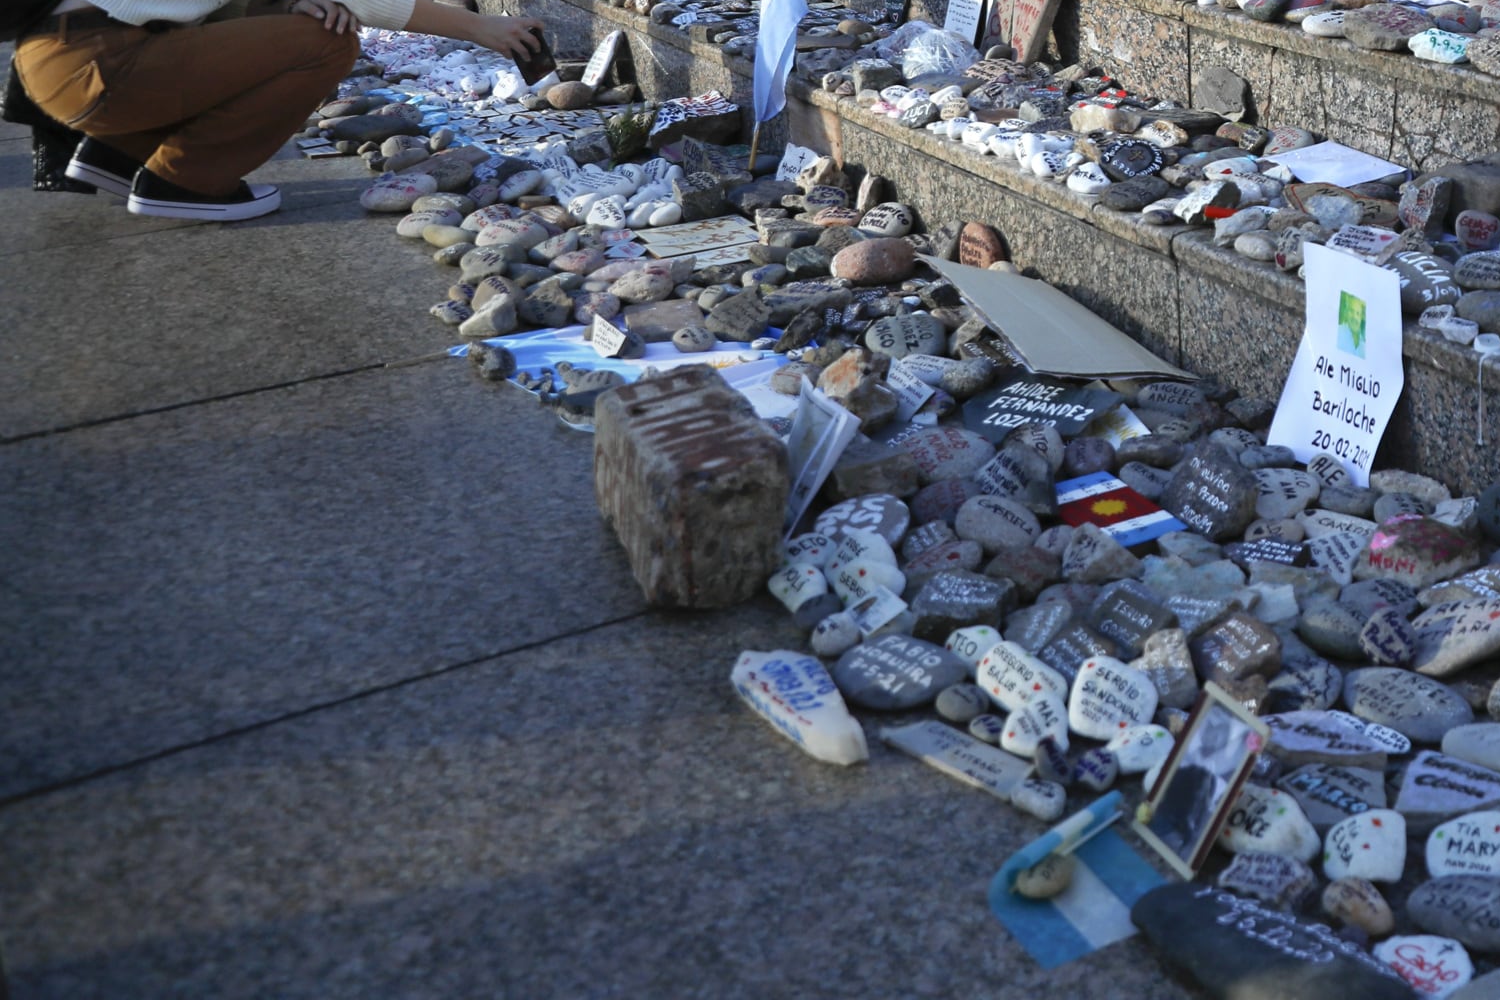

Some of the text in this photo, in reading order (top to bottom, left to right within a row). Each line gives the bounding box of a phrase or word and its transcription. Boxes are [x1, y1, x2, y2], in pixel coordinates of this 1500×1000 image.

[902, 102, 930, 121] LUCY
[1314, 356, 1334, 379] Ale
[989, 396, 1094, 421] FERNANDEZ
[1312, 391, 1376, 435] Bariloche
[1312, 456, 1346, 486] ALE
[1318, 517, 1373, 538] CARLOS
[882, 635, 942, 667] FABIO
[952, 632, 978, 657] TEO
[993, 643, 1035, 682] GREGORIO
[1082, 680, 1140, 722] SANDOVAL
[1446, 836, 1500, 856] MARY
